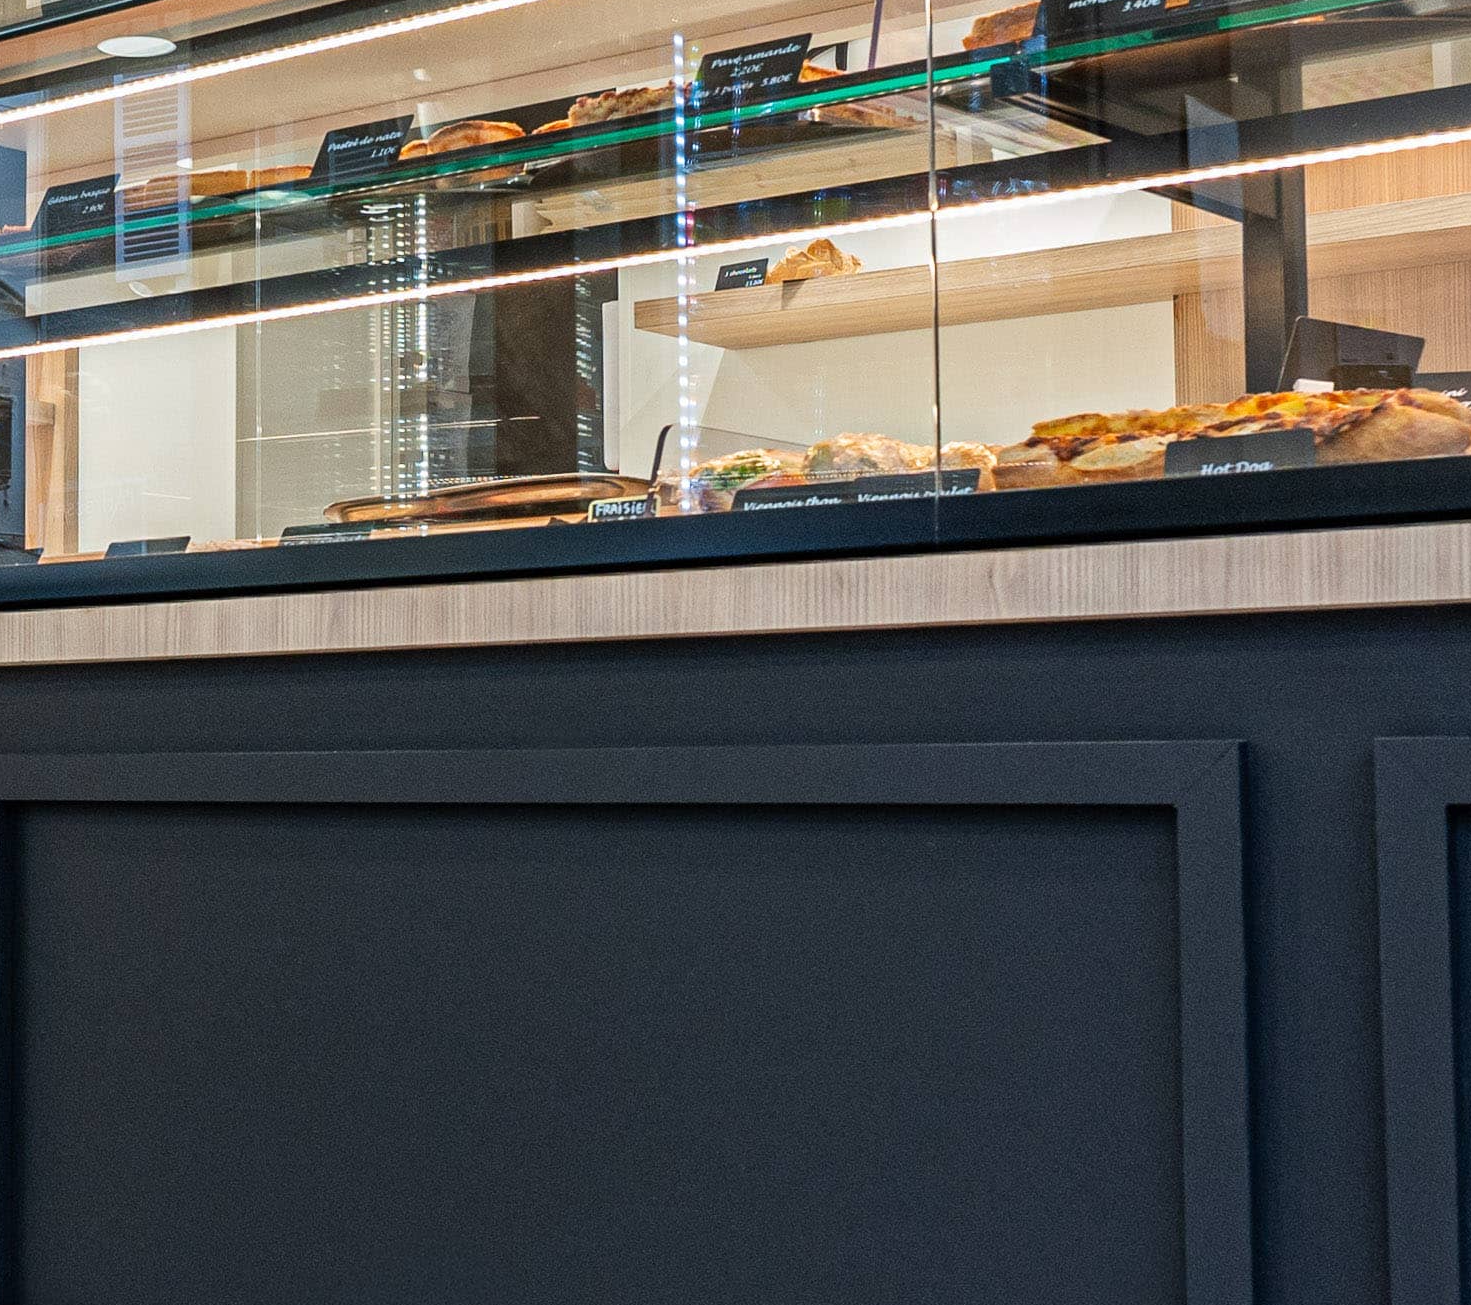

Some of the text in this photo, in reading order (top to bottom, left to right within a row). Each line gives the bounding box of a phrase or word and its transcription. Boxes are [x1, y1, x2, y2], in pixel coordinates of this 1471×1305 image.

[375, 130, 405, 143] nata
[1200, 463, 1235, 476] Hot
[744, 496, 842, 512] Viennois thon
